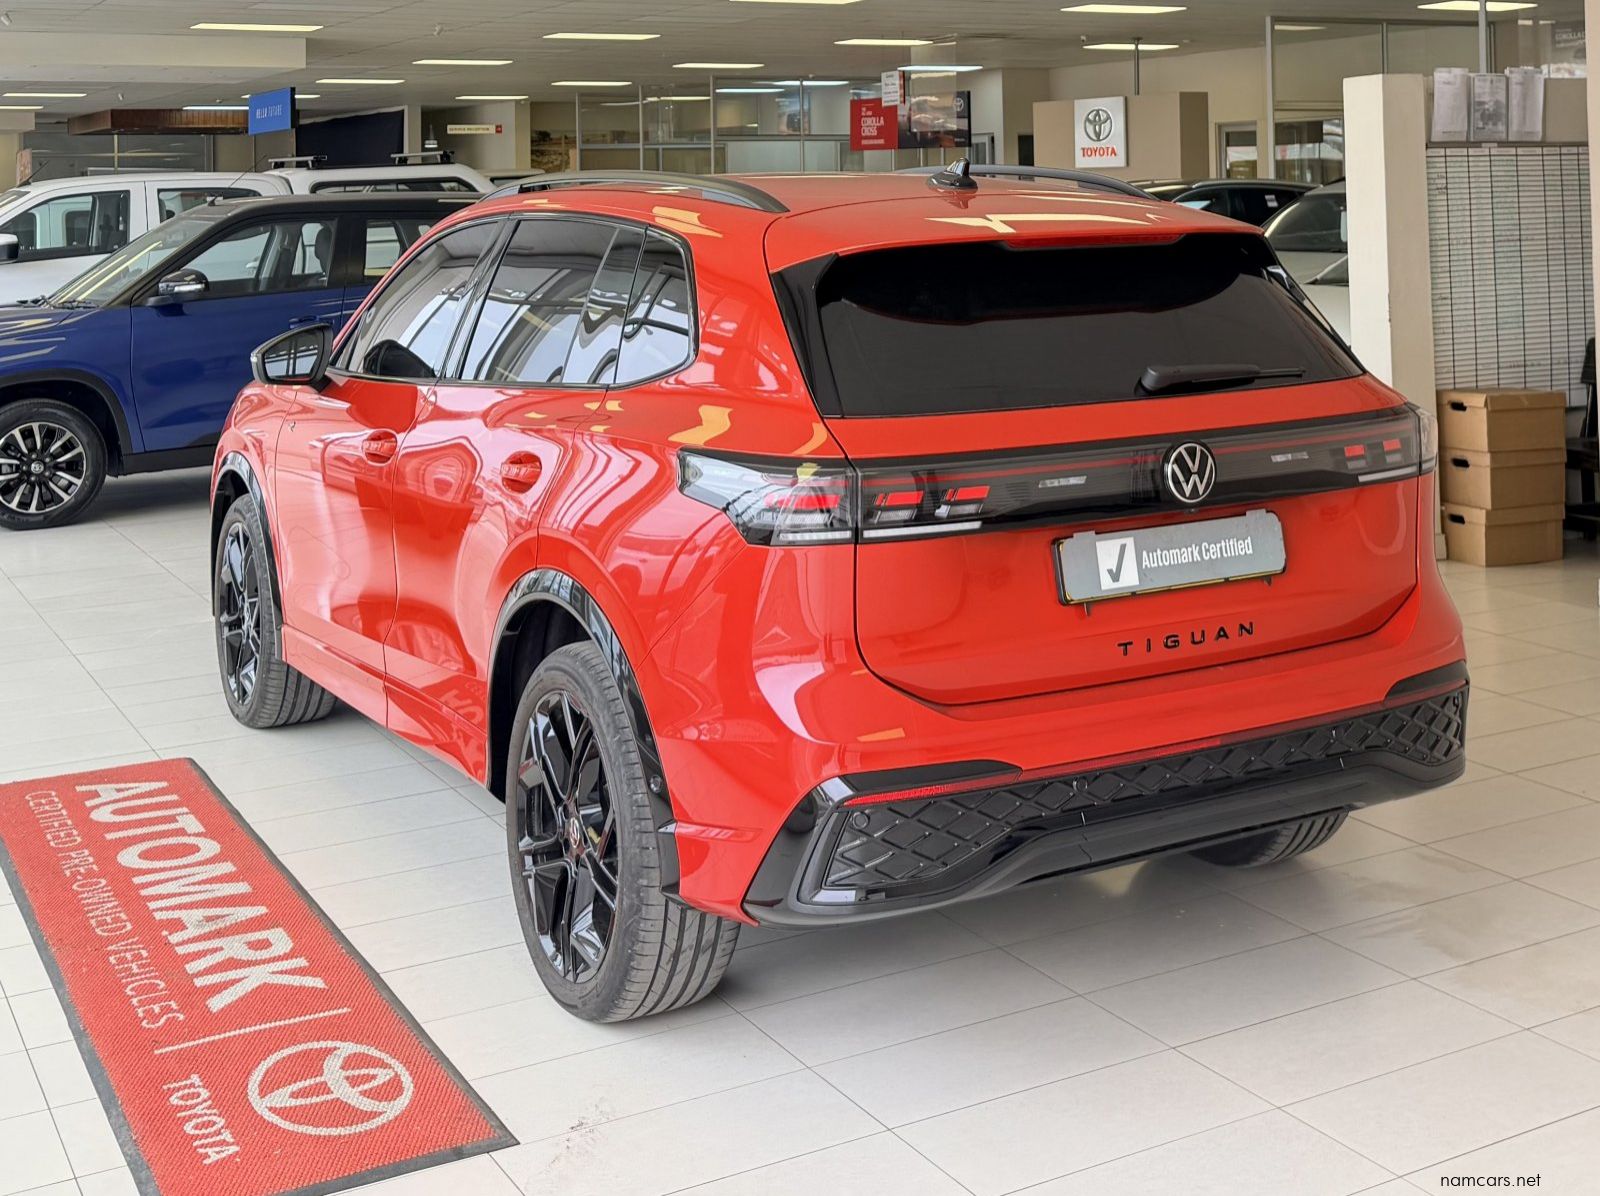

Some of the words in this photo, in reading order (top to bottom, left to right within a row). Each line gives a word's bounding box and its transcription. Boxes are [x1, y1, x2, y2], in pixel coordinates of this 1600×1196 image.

[861, 116, 885, 127] COROLLA
[861, 126, 878, 136] CROSS
[1081, 147, 1117, 157] TOYOTA
[1142, 543, 1201, 569] Automark
[1202, 536, 1254, 561] Certified
[1118, 622, 1254, 656] TIGUAN
[25, 790, 83, 849] CERTIFIED
[58, 848, 134, 937] PRE-OWNED
[107, 937, 185, 1029] VEHICLES
[75, 781, 329, 1014] AUTOMARK
[163, 1073, 241, 1165] TOYOTA
